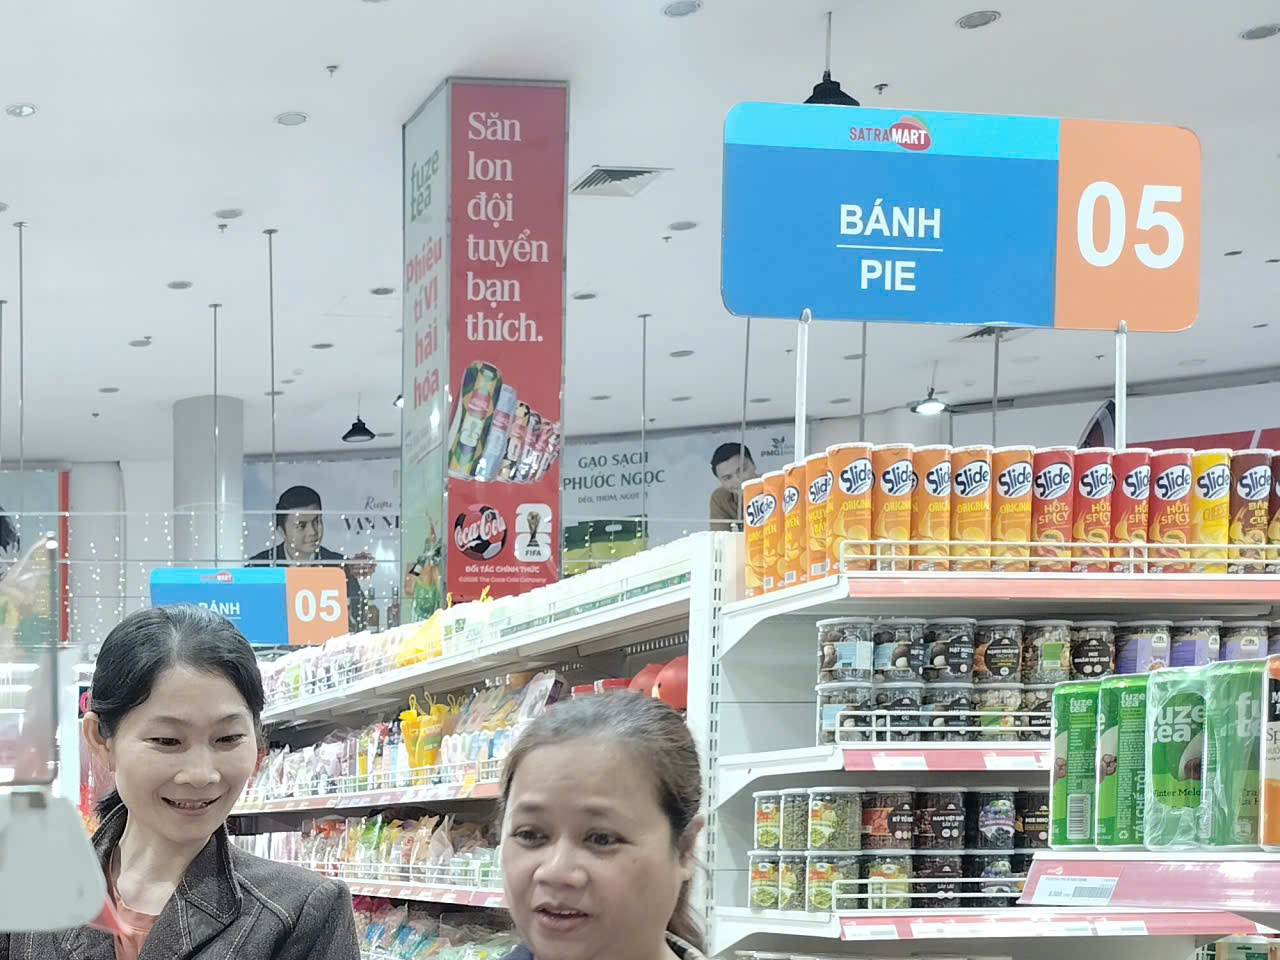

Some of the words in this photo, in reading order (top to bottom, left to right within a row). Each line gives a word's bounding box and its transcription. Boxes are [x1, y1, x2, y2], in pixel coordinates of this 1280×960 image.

[468, 112, 521, 142] Săn
[849, 126, 928, 146] SATRAMART
[467, 151, 513, 182] lon
[467, 191, 514, 228] đội
[839, 198, 942, 239] BÁNH
[1076, 180, 1185, 270] 05
[466, 229, 549, 268] tuyển
[860, 259, 917, 292] PIE
[467, 272, 520, 309] bạn
[465, 312, 544, 342] thích.
[840, 464, 871, 493] Slide
[926, 467, 950, 493] Slid
[955, 467, 990, 495] Slide
[998, 468, 1032, 496] Slide
[1035, 469, 1070, 497] Slide
[1125, 470, 1150, 497] Slid
[1156, 470, 1191, 498] Slide
[1197, 471, 1230, 498] Slide
[1239, 471, 1270, 498] Slide
[295, 589, 342, 622] 05
[1070, 697, 1093, 708] fuze
[1070, 705, 1087, 713] tea
[1121, 691, 1146, 702] fuze
[1121, 699, 1140, 708] tea
[1156, 705, 1207, 724] uze
[1153, 788, 1175, 798] inter
[1179, 787, 1201, 797] Melo
